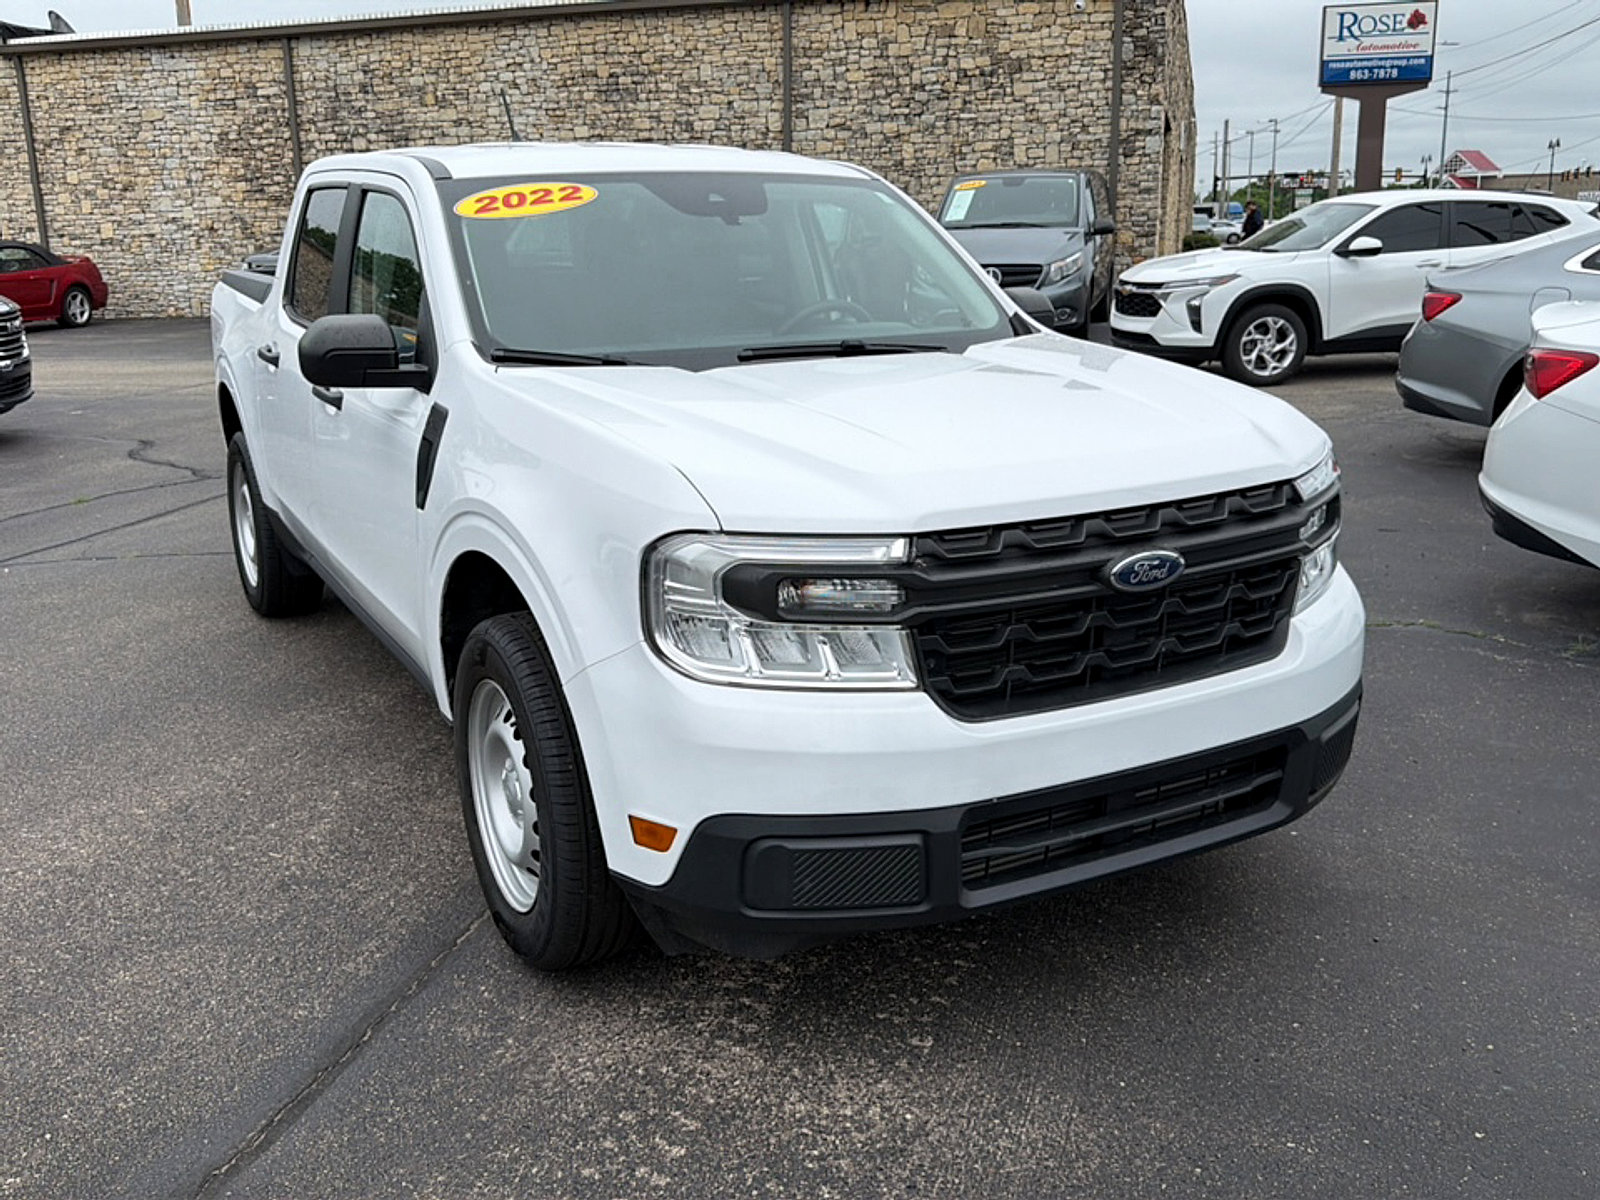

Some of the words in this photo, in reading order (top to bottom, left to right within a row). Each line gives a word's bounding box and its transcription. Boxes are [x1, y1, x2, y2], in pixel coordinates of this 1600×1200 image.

[1335, 11, 1406, 42] ROSE
[1347, 40, 1419, 53] Automotive
[473, 185, 584, 214] 2022
[1130, 559, 1170, 584] Ford
